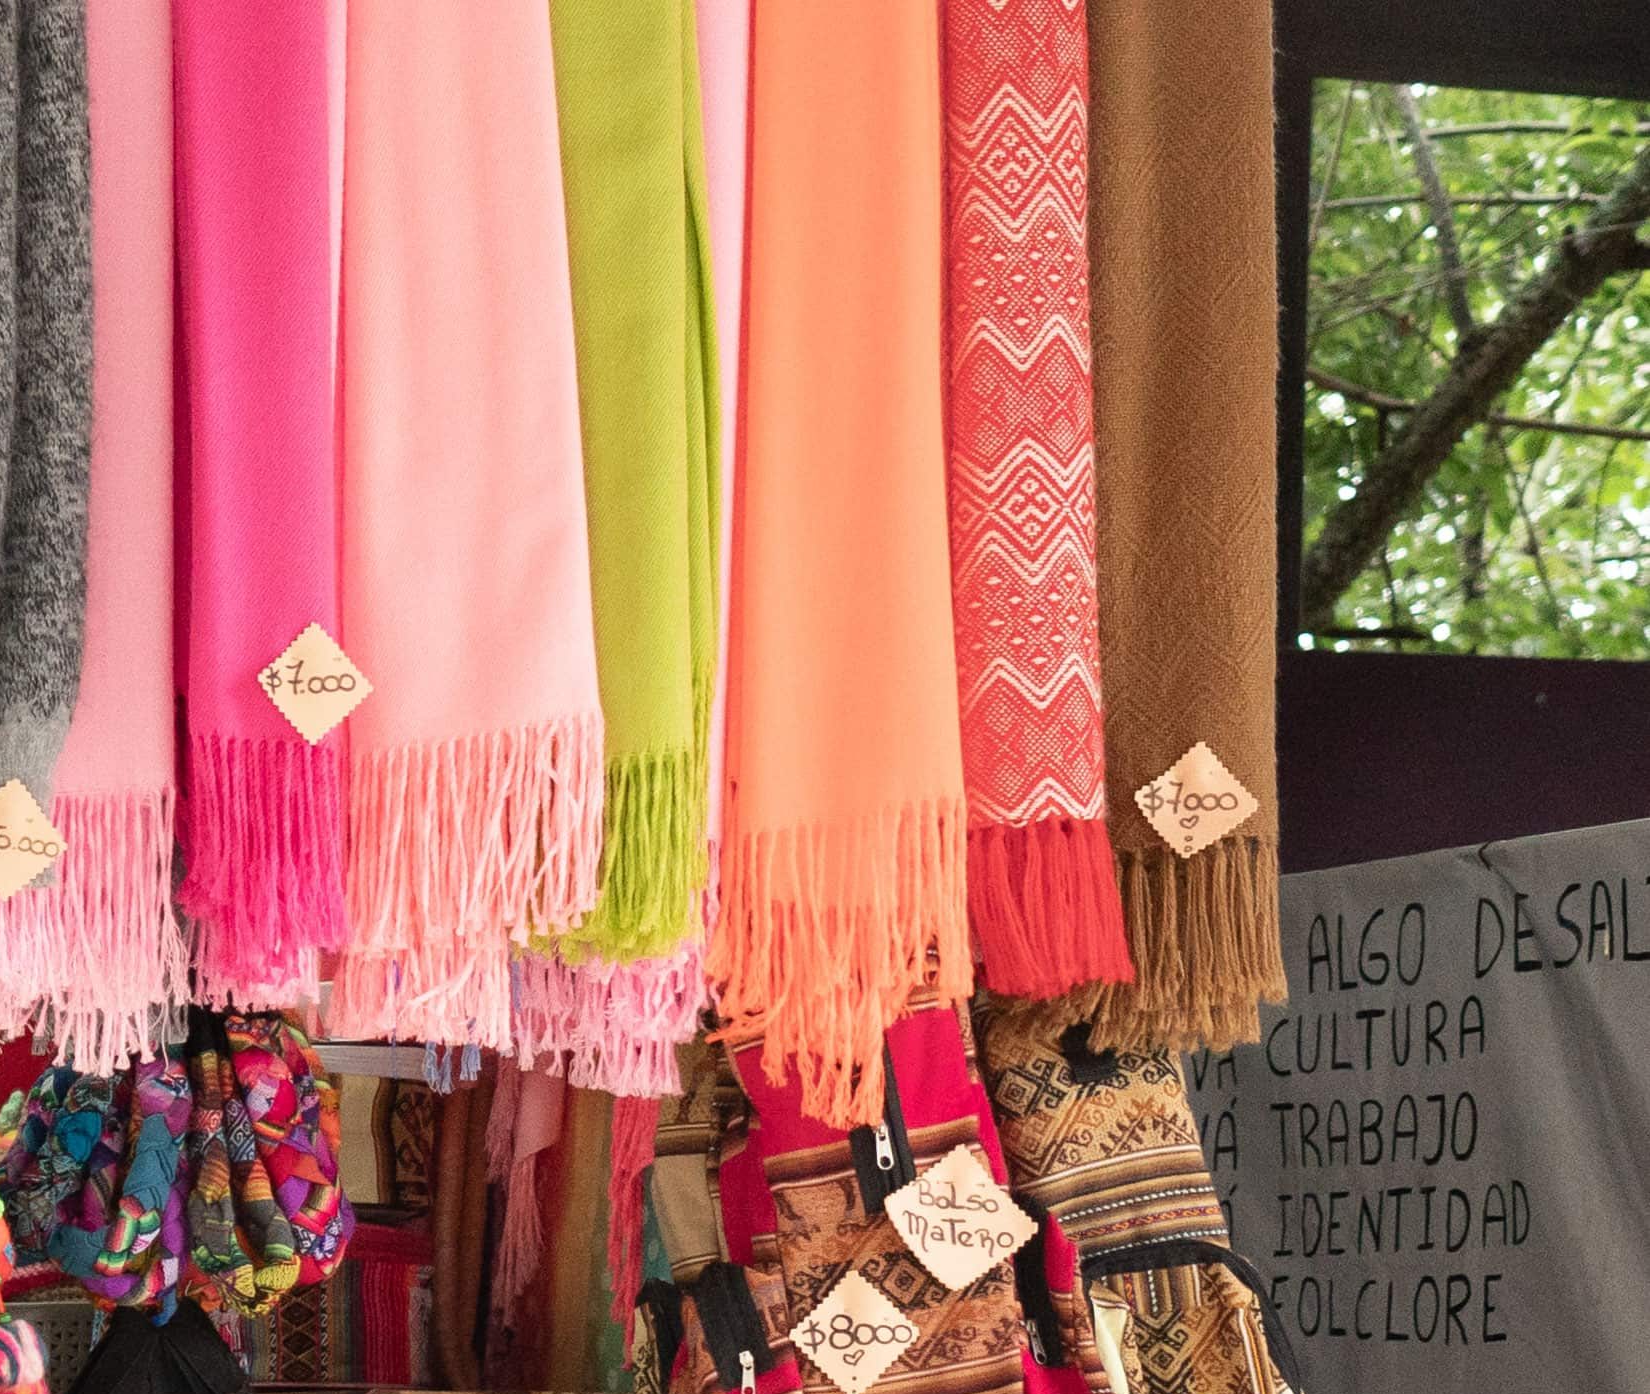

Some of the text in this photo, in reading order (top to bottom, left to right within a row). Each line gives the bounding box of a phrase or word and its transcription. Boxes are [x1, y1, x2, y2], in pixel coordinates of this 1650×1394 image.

[265, 659, 357, 695] $7.000
[1142, 780, 1239, 818] $7000
[1307, 902, 1426, 994] ALGO
[1266, 994, 1486, 1077] CULTURA
[1269, 1091, 1480, 1171] TRABAJO
[1273, 1179, 1531, 1258] IDENTIDAD
[802, 1314, 914, 1354] $8000
